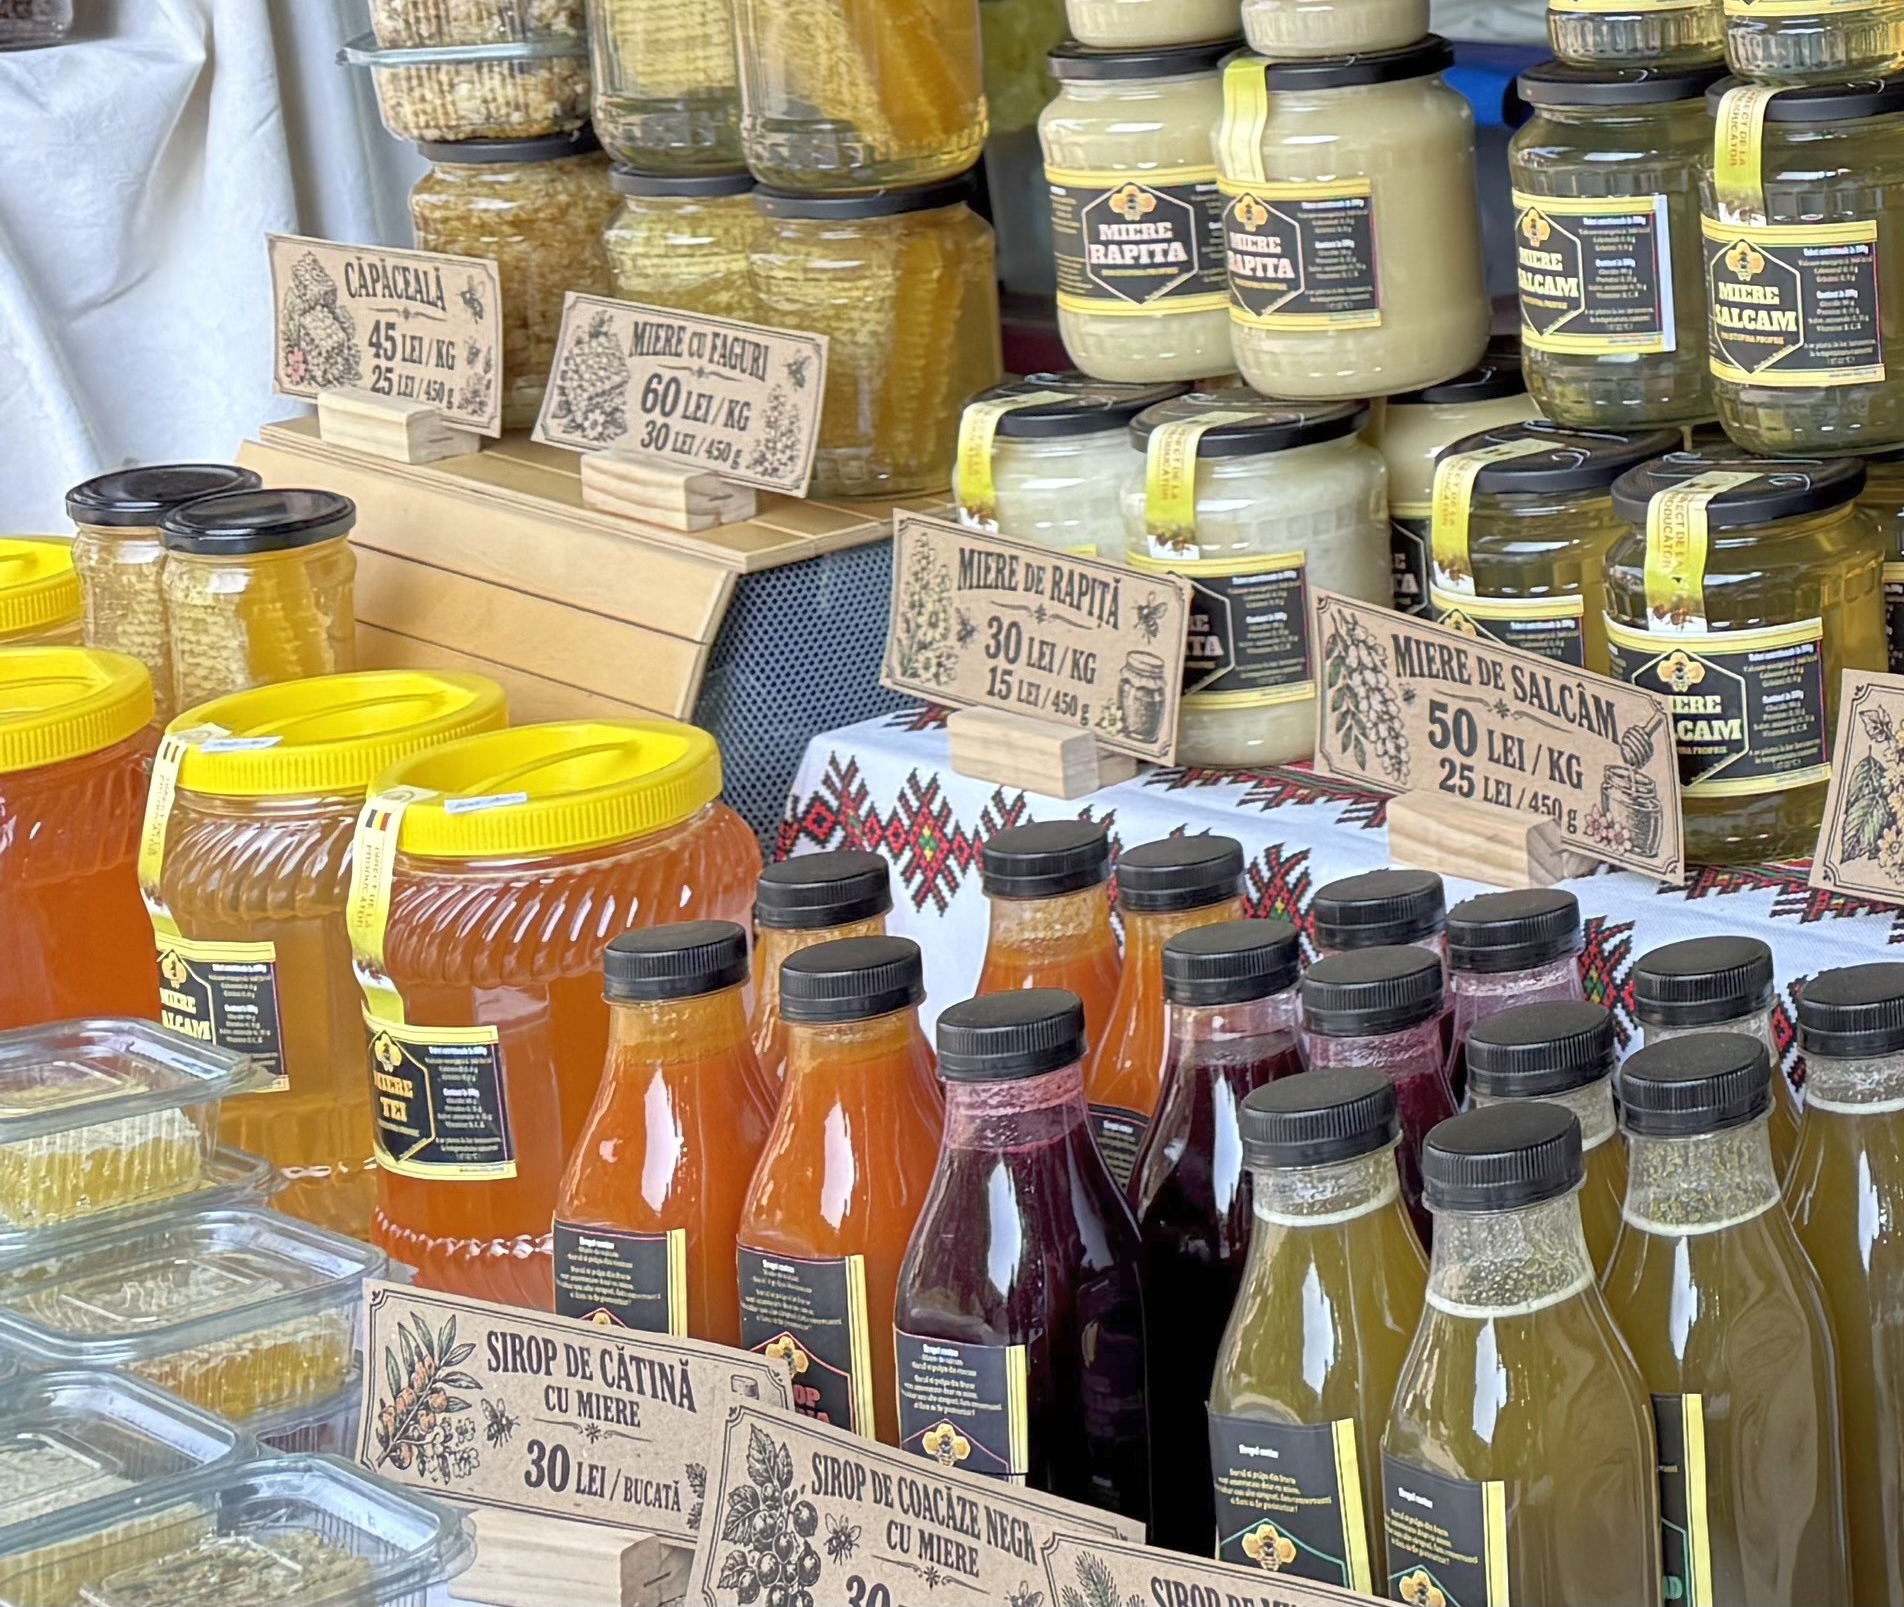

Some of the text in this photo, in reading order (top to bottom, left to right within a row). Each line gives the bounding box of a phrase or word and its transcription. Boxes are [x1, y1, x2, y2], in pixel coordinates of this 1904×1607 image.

[344, 256, 447, 312] CĂPĂCEALĂ
[1718, 282, 1780, 305] MIERE
[368, 320, 397, 361] 45
[401, 333, 423, 365] LEI
[435, 339, 456, 370] KG
[1715, 304, 1797, 332] SALCAM
[629, 321, 769, 382] MIERE CU FAGURI
[370, 365, 394, 395] 25
[397, 373, 416, 398] LEI
[425, 377, 445, 404] 450
[446, 388, 454, 409] g
[641, 373, 681, 417] 60
[681, 390, 714, 424] LEI
[723, 399, 751, 431] KG
[958, 547, 1121, 631] MIERE DE RAPIȚĂ
[985, 615, 1022, 665] 30
[1027, 636, 1056, 673] LEI
[1070, 648, 1097, 685] KG
[1391, 633, 1620, 744] MIERE DE SALCÂM
[1428, 698, 1478, 757] 50
[1487, 729, 1526, 772] LEI
[1548, 746, 1584, 790] KG
[486, 1330, 697, 1414] SIROP DE CĂTINĂ
[544, 1384, 641, 1428] CU MIERE
[524, 1439, 571, 1493] 30
[575, 1461, 606, 1499] LEI
[623, 1476, 682, 1512] BUCATĂ
[811, 1451, 867, 1504] SIROP
[871, 1471, 894, 1507] DE
[898, 1477, 982, 1541] COACĂZE
[886, 1520, 981, 1579] CU MIERE
